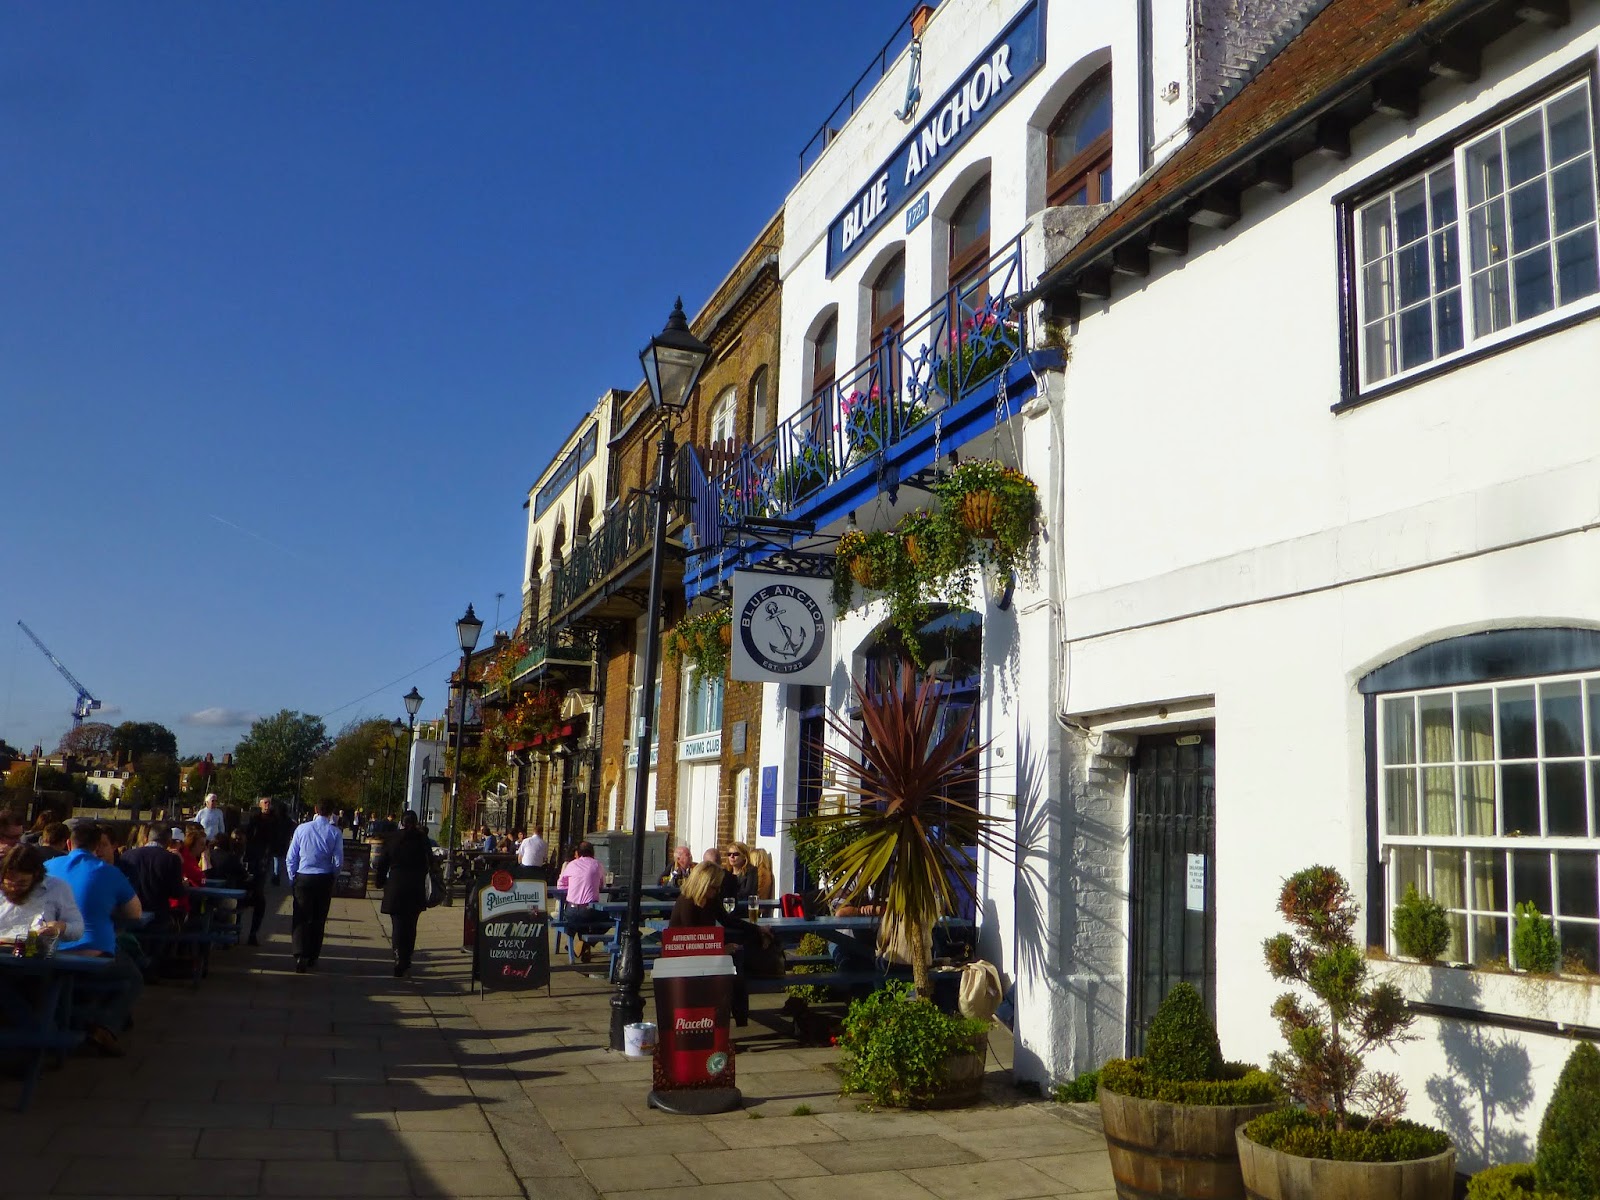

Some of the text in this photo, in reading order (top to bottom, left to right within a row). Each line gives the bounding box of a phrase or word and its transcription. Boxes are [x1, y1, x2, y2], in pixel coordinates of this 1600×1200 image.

[842, 44, 1013, 252] BLUE ANCHOR
[742, 586, 824, 632] BLUE ANCHOR
[763, 660, 804, 671] EST. 1722
[685, 739, 720, 756] ROWING CLUB
[487, 891, 540, 911] Pilsner Urquell
[485, 921, 544, 937] QUIZ NIGHT
[498, 939, 526, 949] EVERY
[697, 933, 715, 941] ITALIAN
[686, 942, 704, 950] GROUND
[705, 941, 722, 949] COFFEE
[675, 1017, 714, 1030] Piacetto
